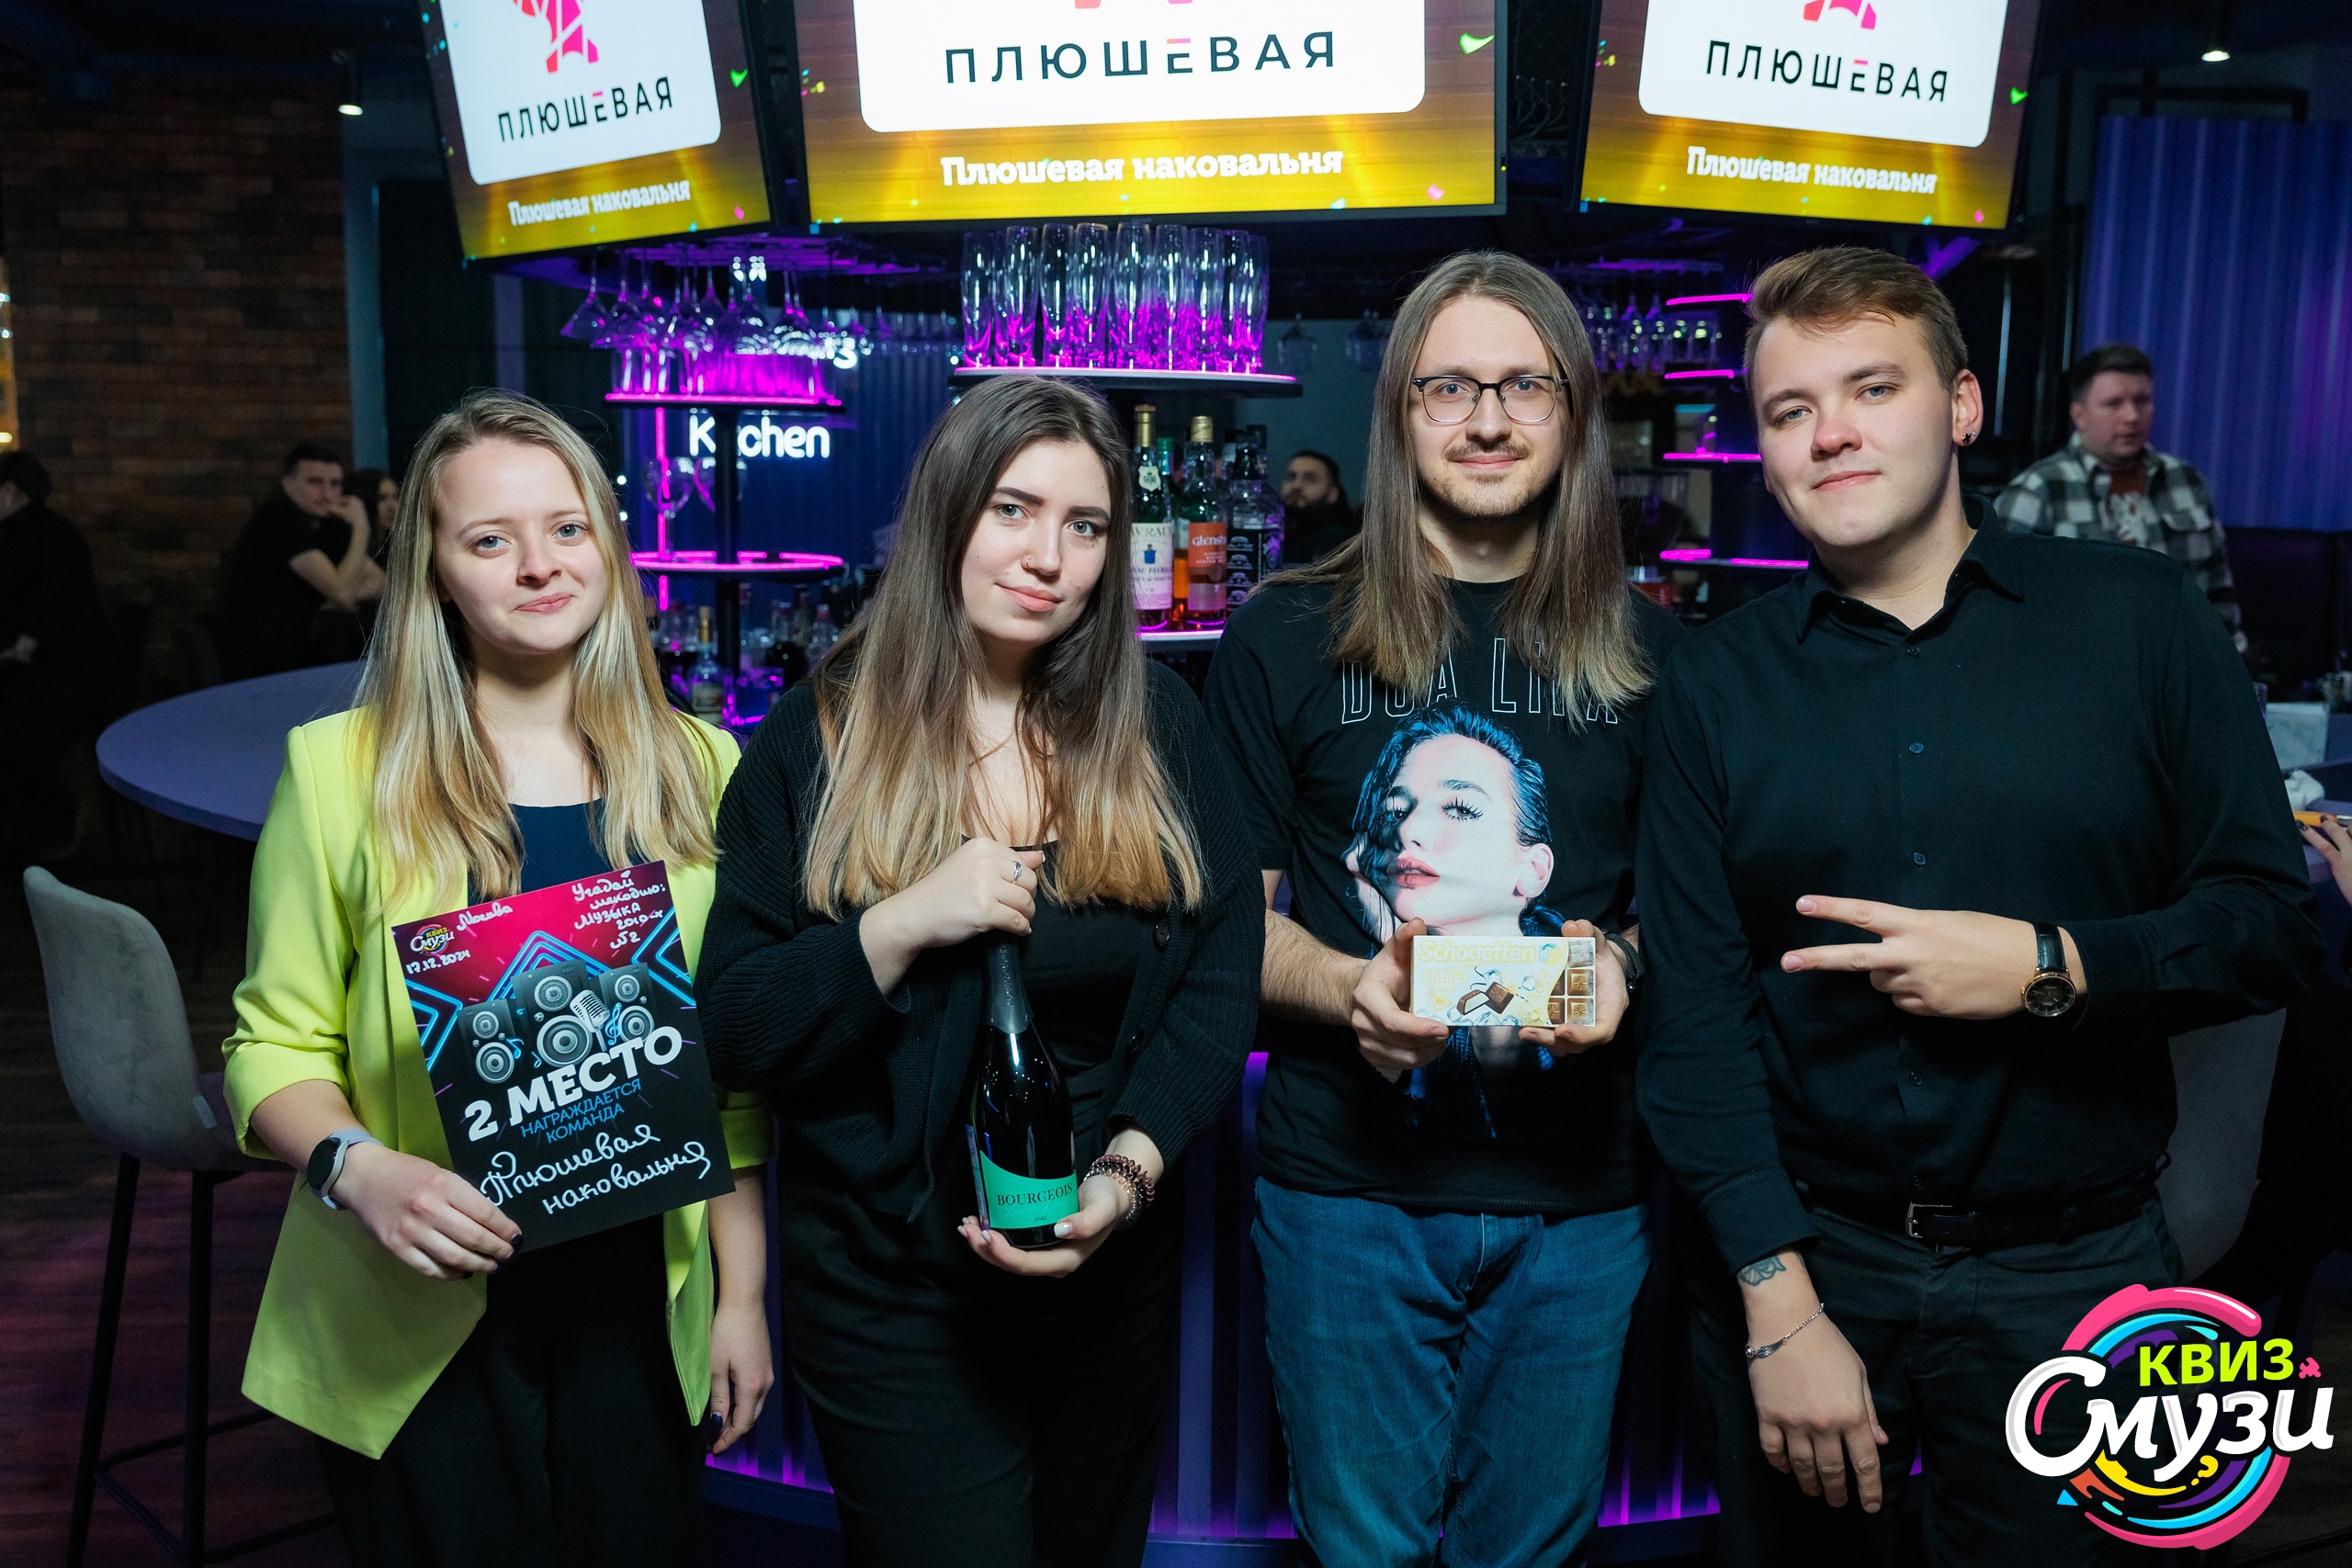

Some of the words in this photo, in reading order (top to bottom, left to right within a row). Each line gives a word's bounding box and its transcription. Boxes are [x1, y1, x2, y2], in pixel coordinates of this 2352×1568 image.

[945, 31, 1335, 85] ПЛЮШЕВАЯ
[1706, 39, 1948, 103] ПЛЮШЕВАЯ
[497, 76, 673, 143] ПЛЮШЕВАЯ
[940, 155, 1125, 186] Плюшевая
[1133, 149, 1344, 182] наковальня
[1685, 145, 1810, 186] Плюшевая
[1814, 164, 1938, 195] наковальня
[507, 196, 590, 227] Плюшевая
[591, 180, 691, 215] наковальня
[689, 412, 831, 458] Kchen
[571, 870, 635, 902] Угадай
[410, 931, 456, 953] Смузи
[425, 927, 448, 938] КВИЗ
[1419, 940, 1536, 967] Schogetten
[405, 949, 471, 975] 17.12.2024
[464, 1100, 499, 1142] 2
[506, 1025, 684, 1127] МЕСТО
[521, 1078, 642, 1138] НАГРАЖДАЕТСЯ
[546, 1102, 625, 1143] КОМАНДА
[481, 1123, 662, 1207] Плюшевая
[542, 1141, 712, 1214] наковальня
[997, 1182, 1073, 1206] BOURGEOIS
